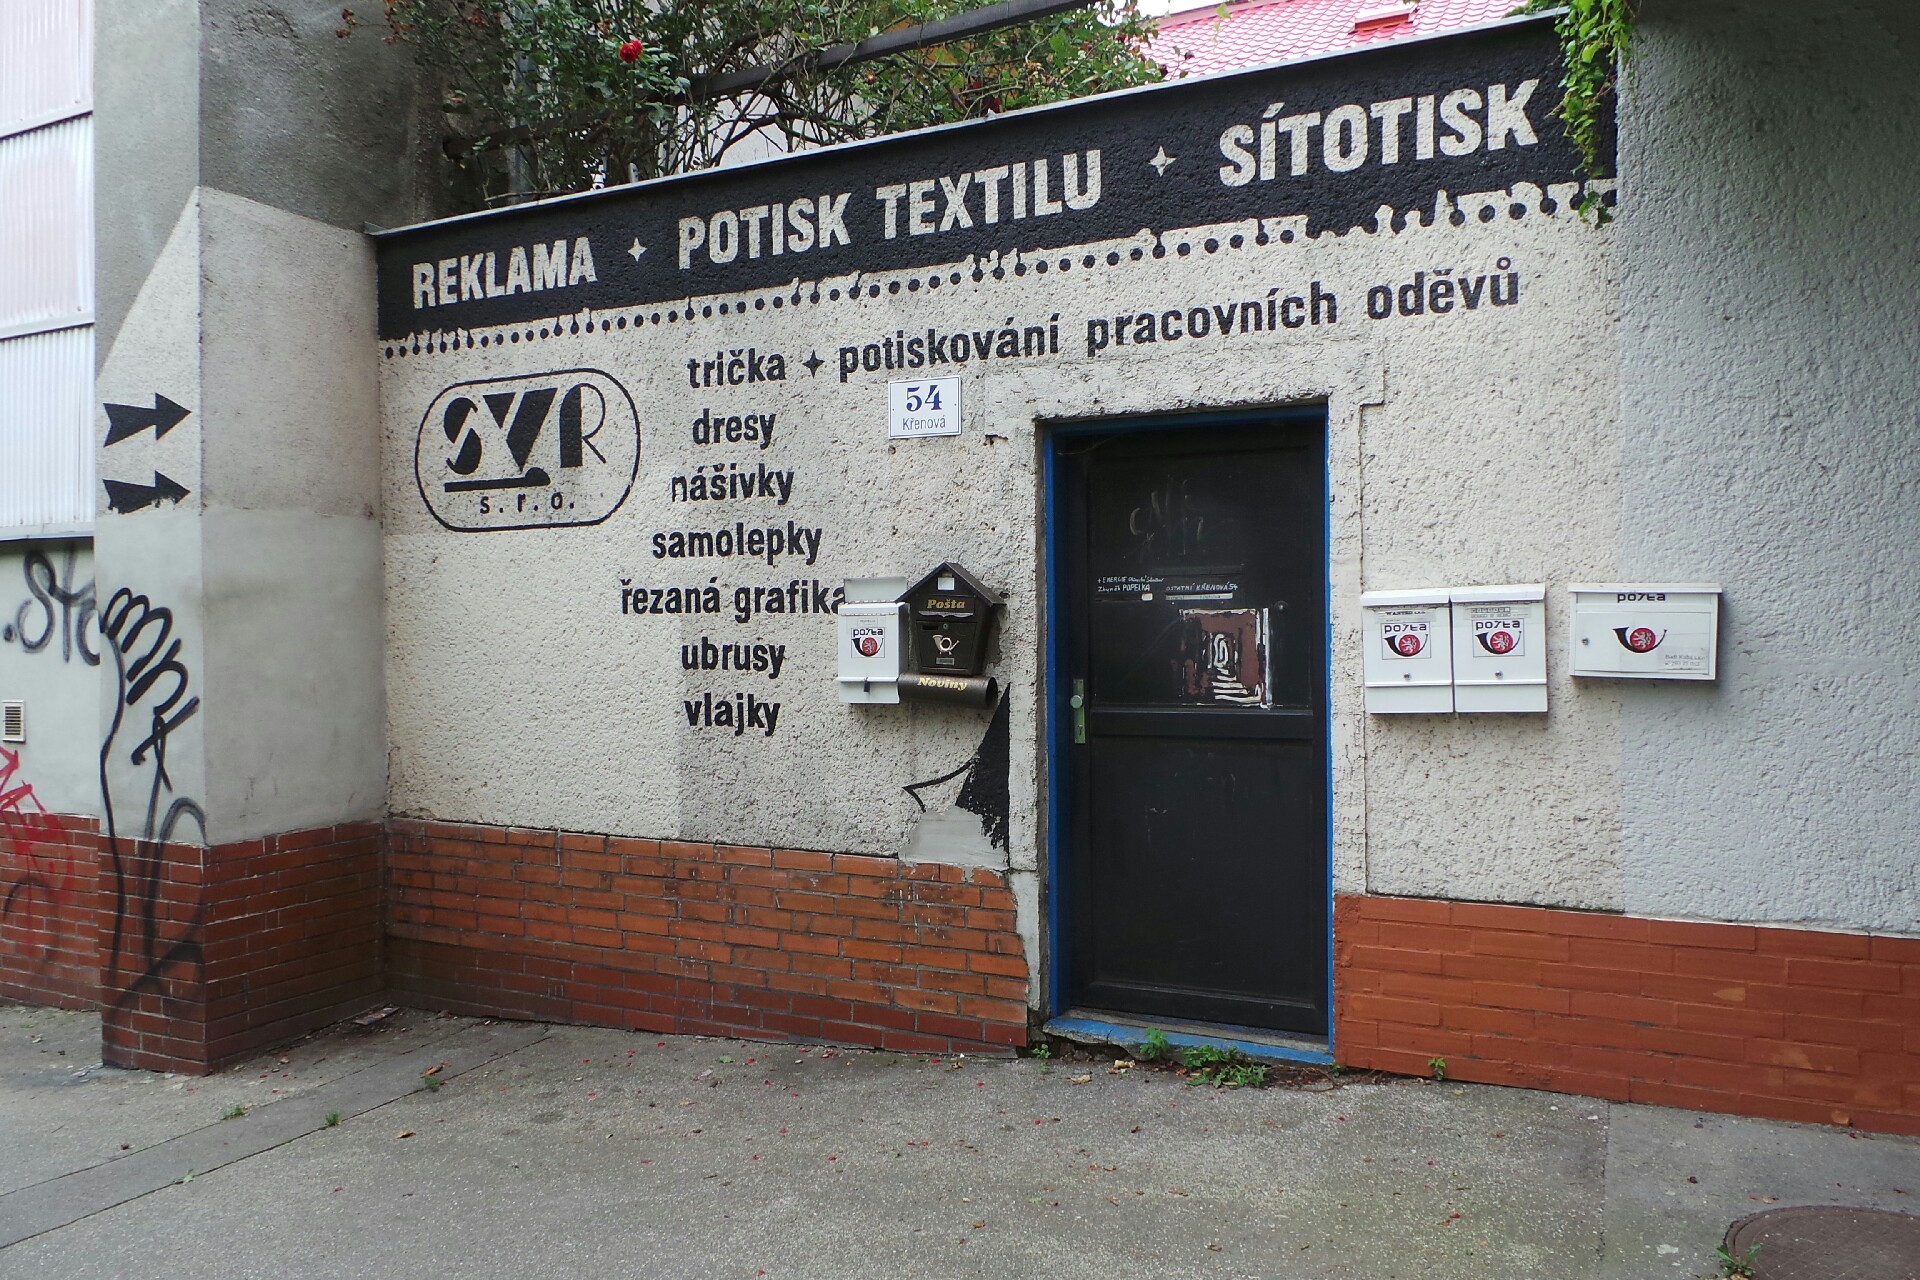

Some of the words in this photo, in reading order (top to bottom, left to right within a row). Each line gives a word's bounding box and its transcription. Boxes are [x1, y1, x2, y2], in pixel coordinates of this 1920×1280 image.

[412, 236, 598, 309] REKLAMA
[678, 192, 852, 270] POTISK
[876, 149, 1101, 240] TEXTILU
[1219, 78, 1540, 187] SÍTOTISK
[687, 348, 786, 389] trička
[839, 313, 1060, 383] potiskování
[1087, 281, 1337, 357] pracovních
[1367, 257, 1519, 320] oděvů
[906, 384, 943, 412] 54
[692, 408, 777, 450] dresy
[902, 414, 946, 431] Křenová
[671, 463, 794, 506] nášivky
[652, 521, 822, 566] samolepky
[620, 577, 721, 615] řezaná
[926, 598, 966, 609] Pošta
[1122, 583, 1151, 592] POPELKA
[682, 637, 786, 679] ubrusy
[917, 677, 968, 691] Noviny
[684, 692, 781, 736] vlajky
